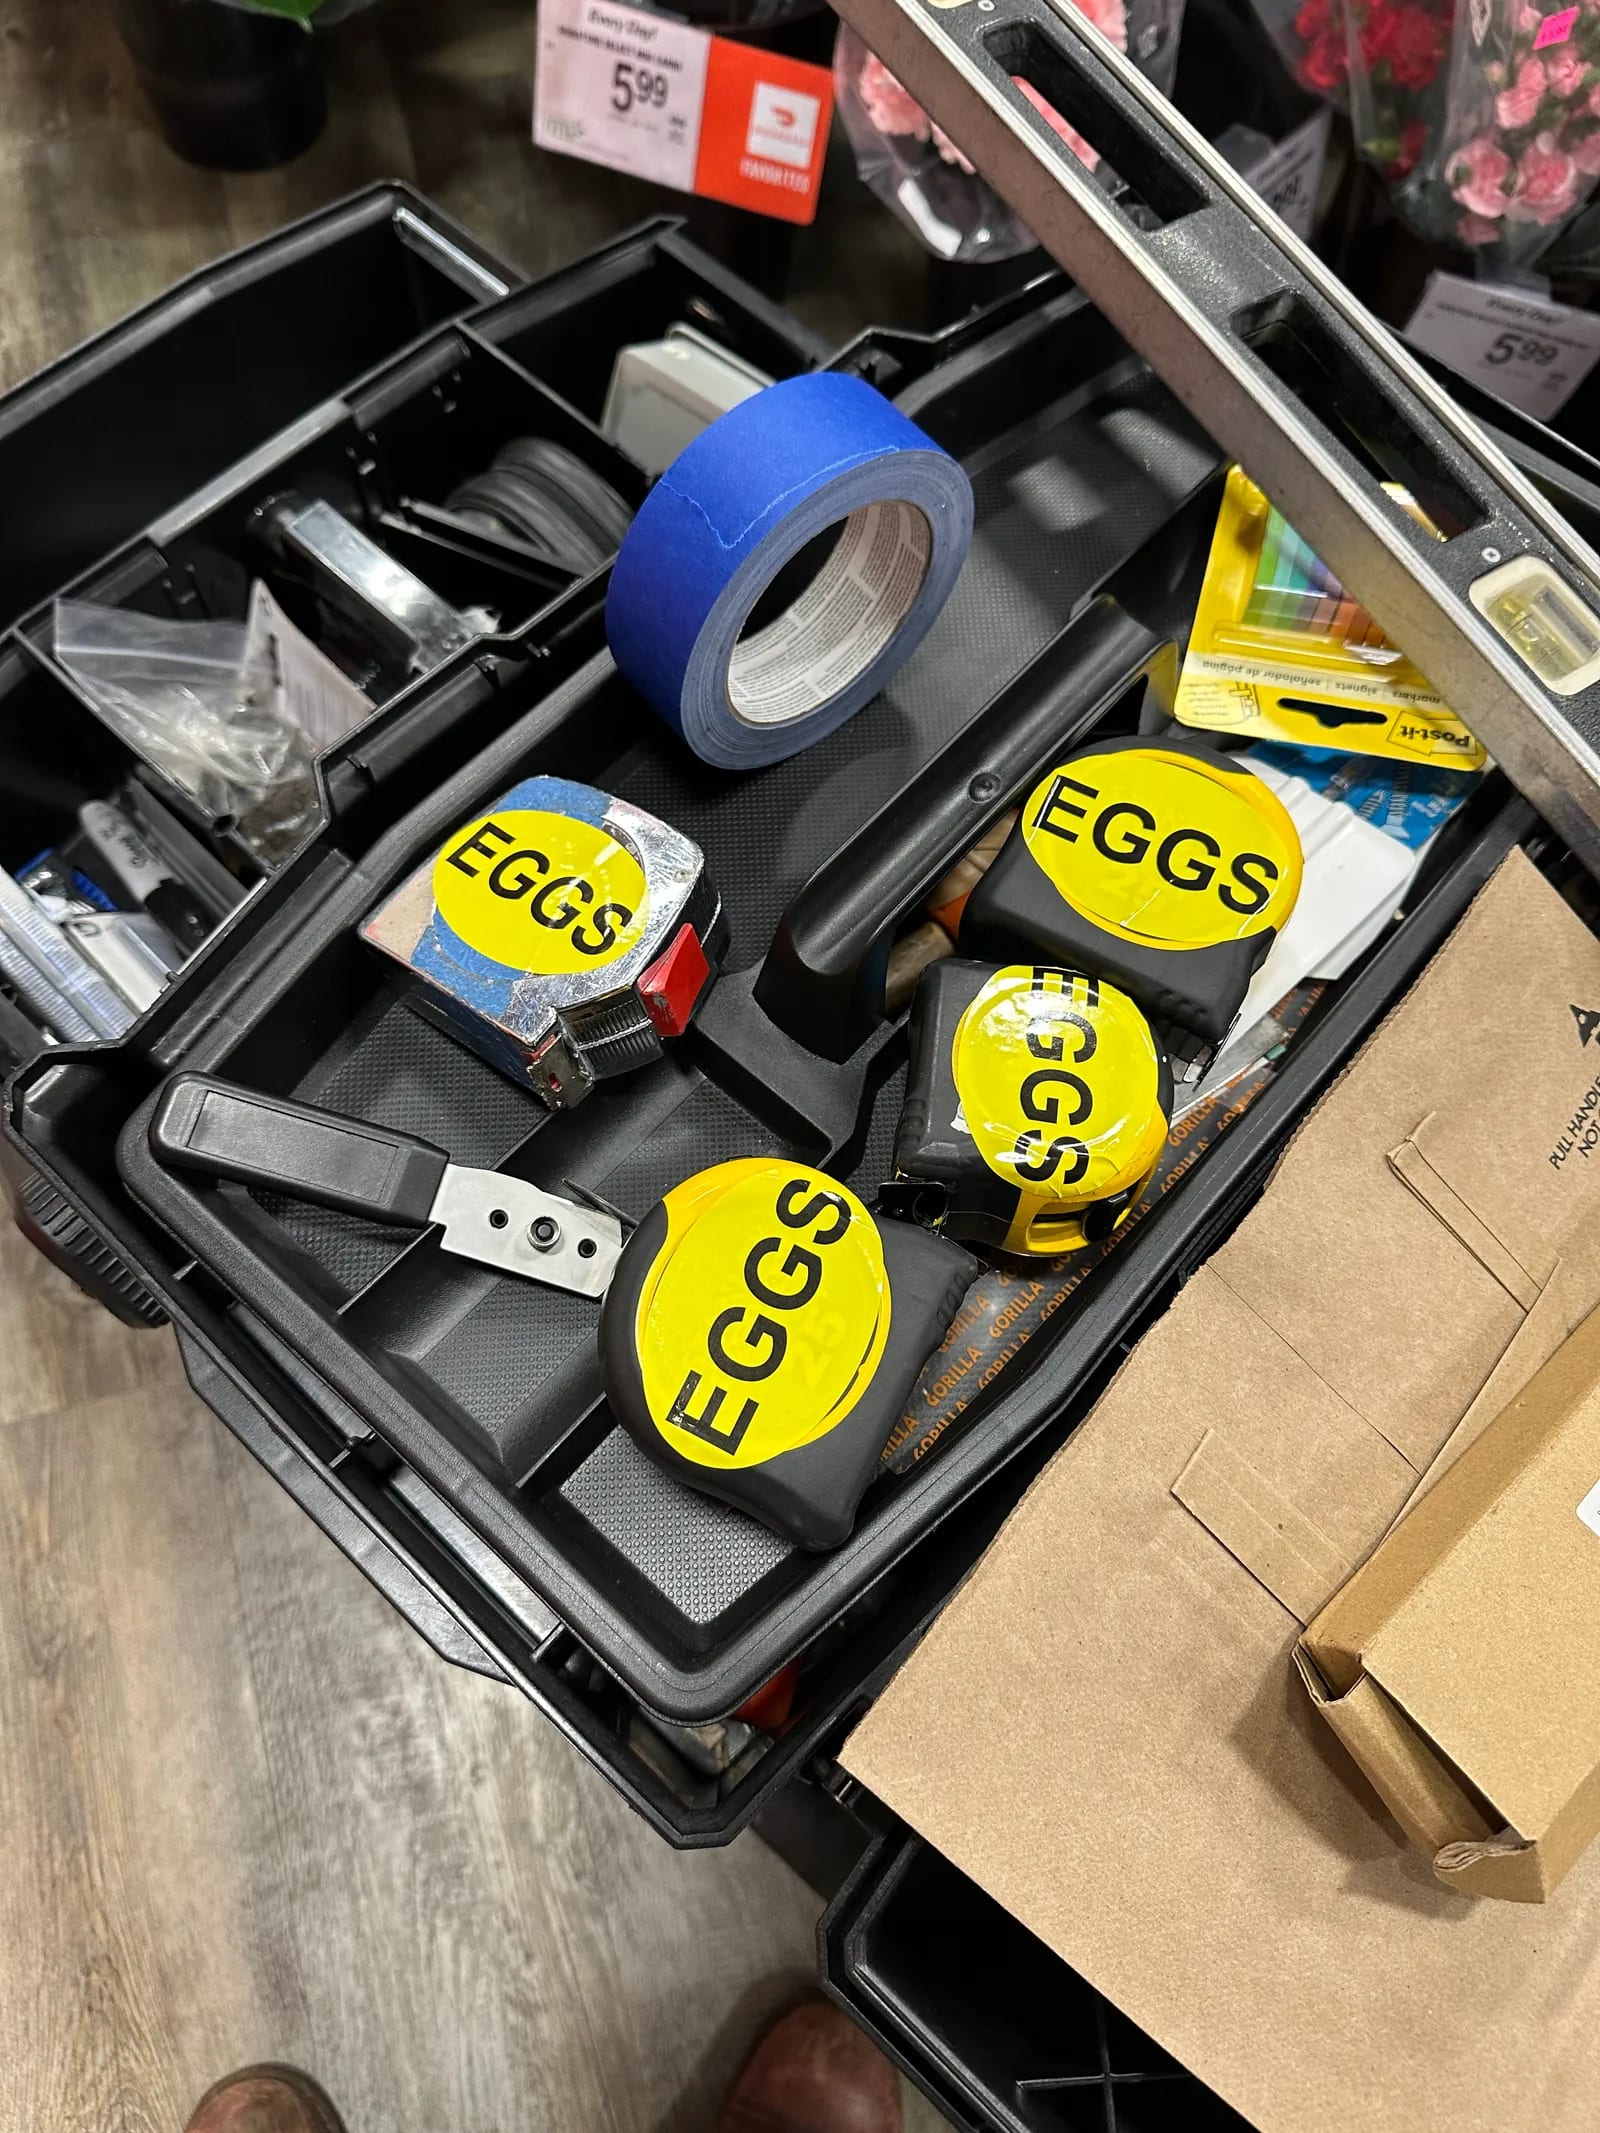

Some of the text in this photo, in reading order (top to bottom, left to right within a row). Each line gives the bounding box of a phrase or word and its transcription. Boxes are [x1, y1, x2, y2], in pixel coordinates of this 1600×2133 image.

[1335, 682, 1378, 696] signets
[446, 821, 633, 955] EGGS
[1031, 775, 1279, 915] EGGS
[1013, 967, 1099, 1185] EGGS
[1549, 1136, 1574, 1170] PULL
[665, 1179, 852, 1456] EGGS
[988, 1280, 1045, 1338] GORILLA
[926, 1346, 983, 1407] GORILLA
